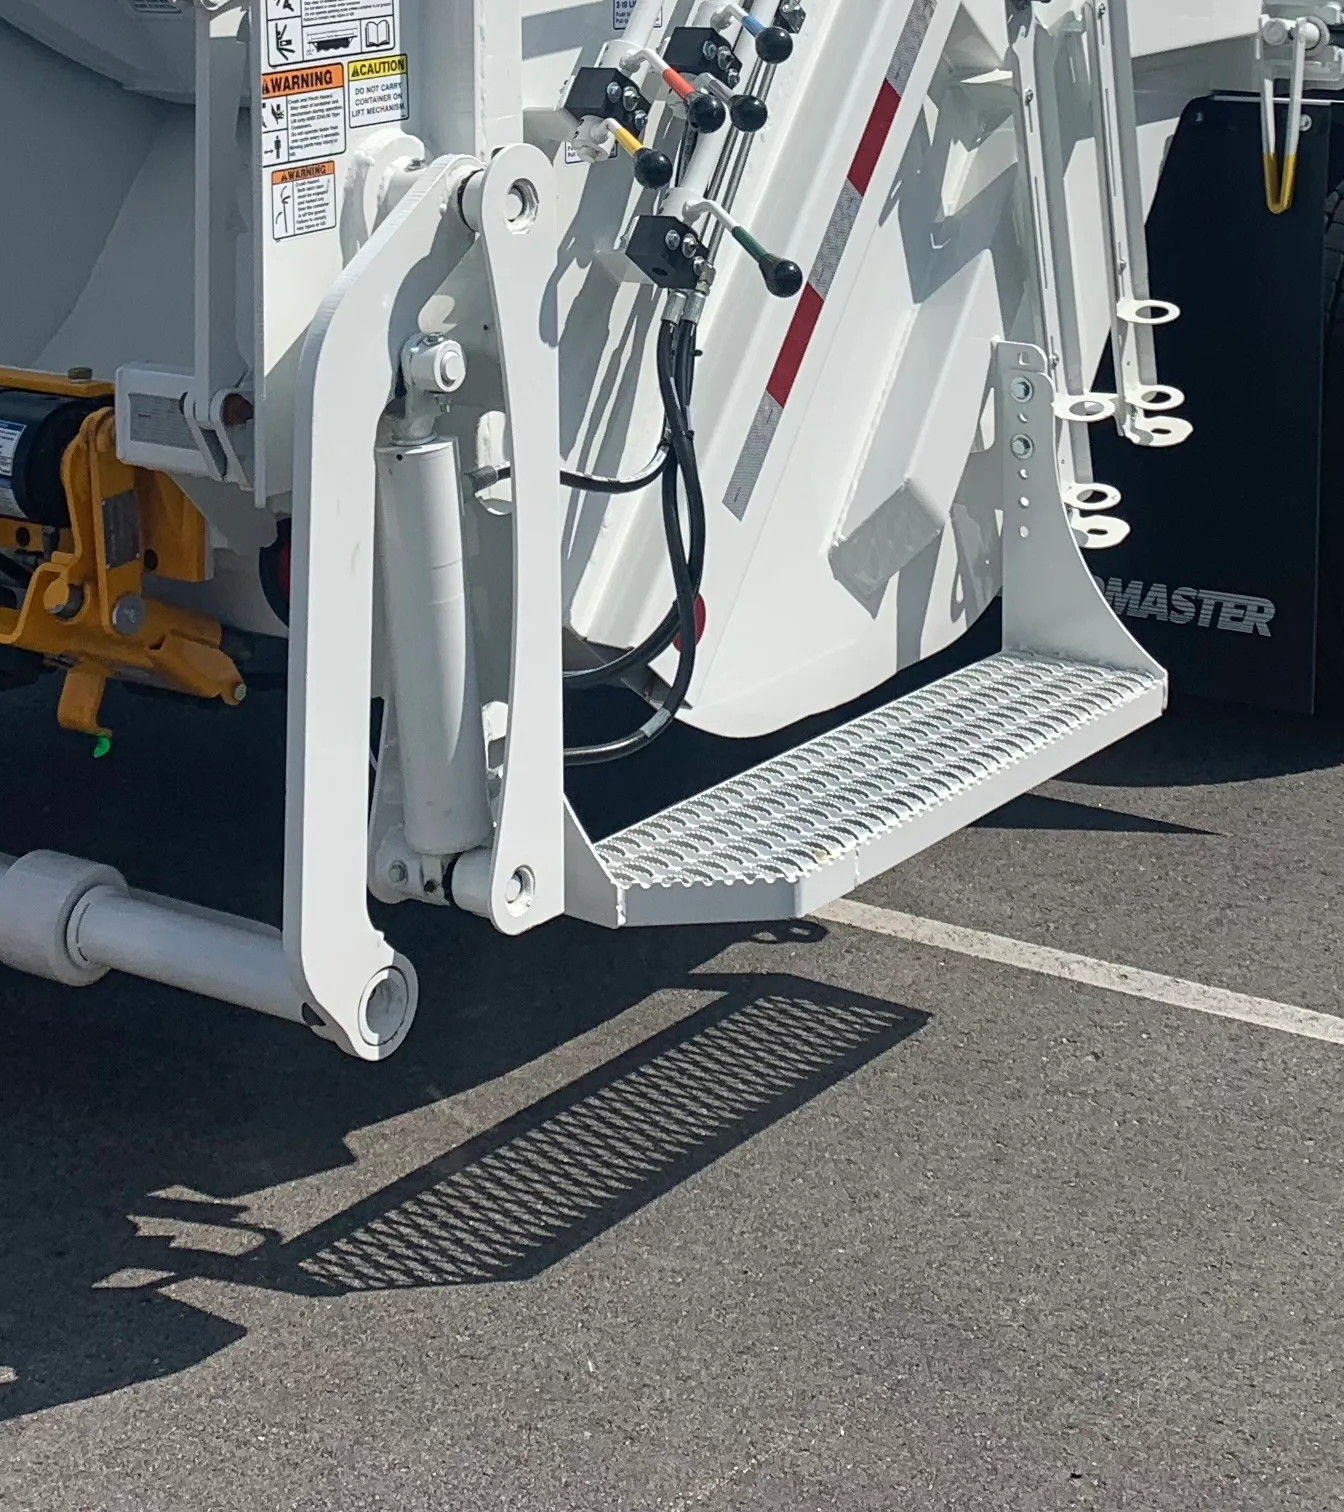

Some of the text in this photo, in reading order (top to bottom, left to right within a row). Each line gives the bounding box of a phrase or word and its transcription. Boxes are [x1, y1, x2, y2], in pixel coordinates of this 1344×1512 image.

[360, 59, 405, 76] CAUTION
[271, 70, 333, 93] WARNING
[355, 82, 402, 95] DO NOT CARRY
[355, 94, 392, 106] CONTAINER
[352, 109, 365, 118] LIFT
[288, 165, 326, 180] WARNING
[1092, 575, 1276, 637] MASTER
